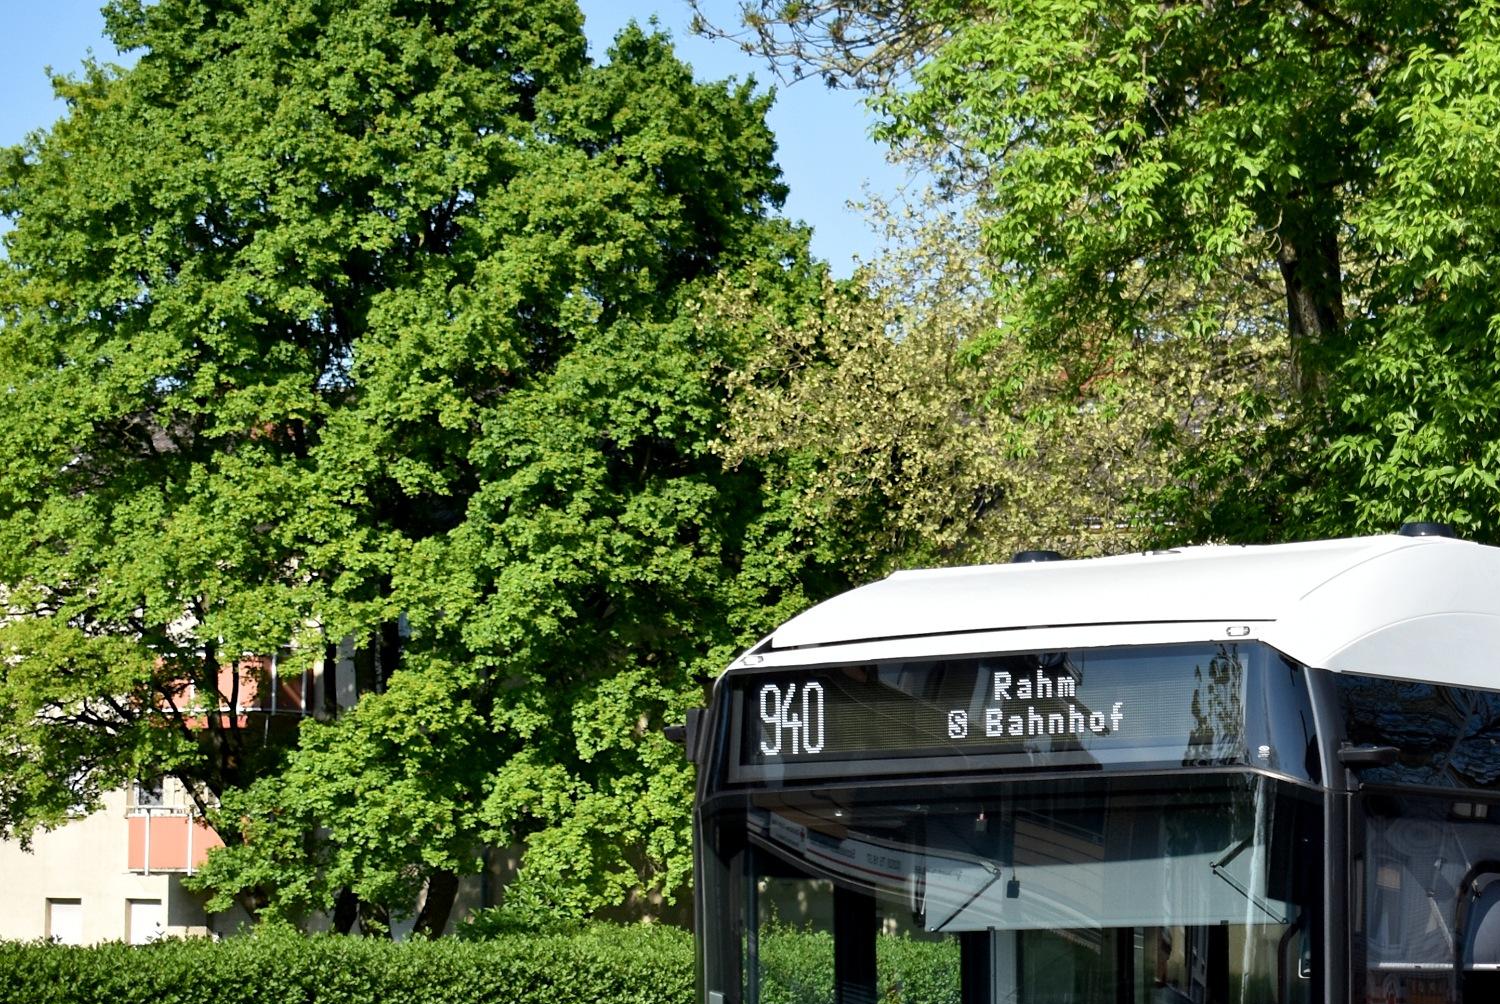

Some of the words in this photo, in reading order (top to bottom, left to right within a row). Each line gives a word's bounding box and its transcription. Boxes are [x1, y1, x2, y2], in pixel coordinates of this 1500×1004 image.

[994, 666, 1076, 700] Rahm
[759, 682, 825, 755] 940
[985, 702, 1123, 738] Bahnhof
